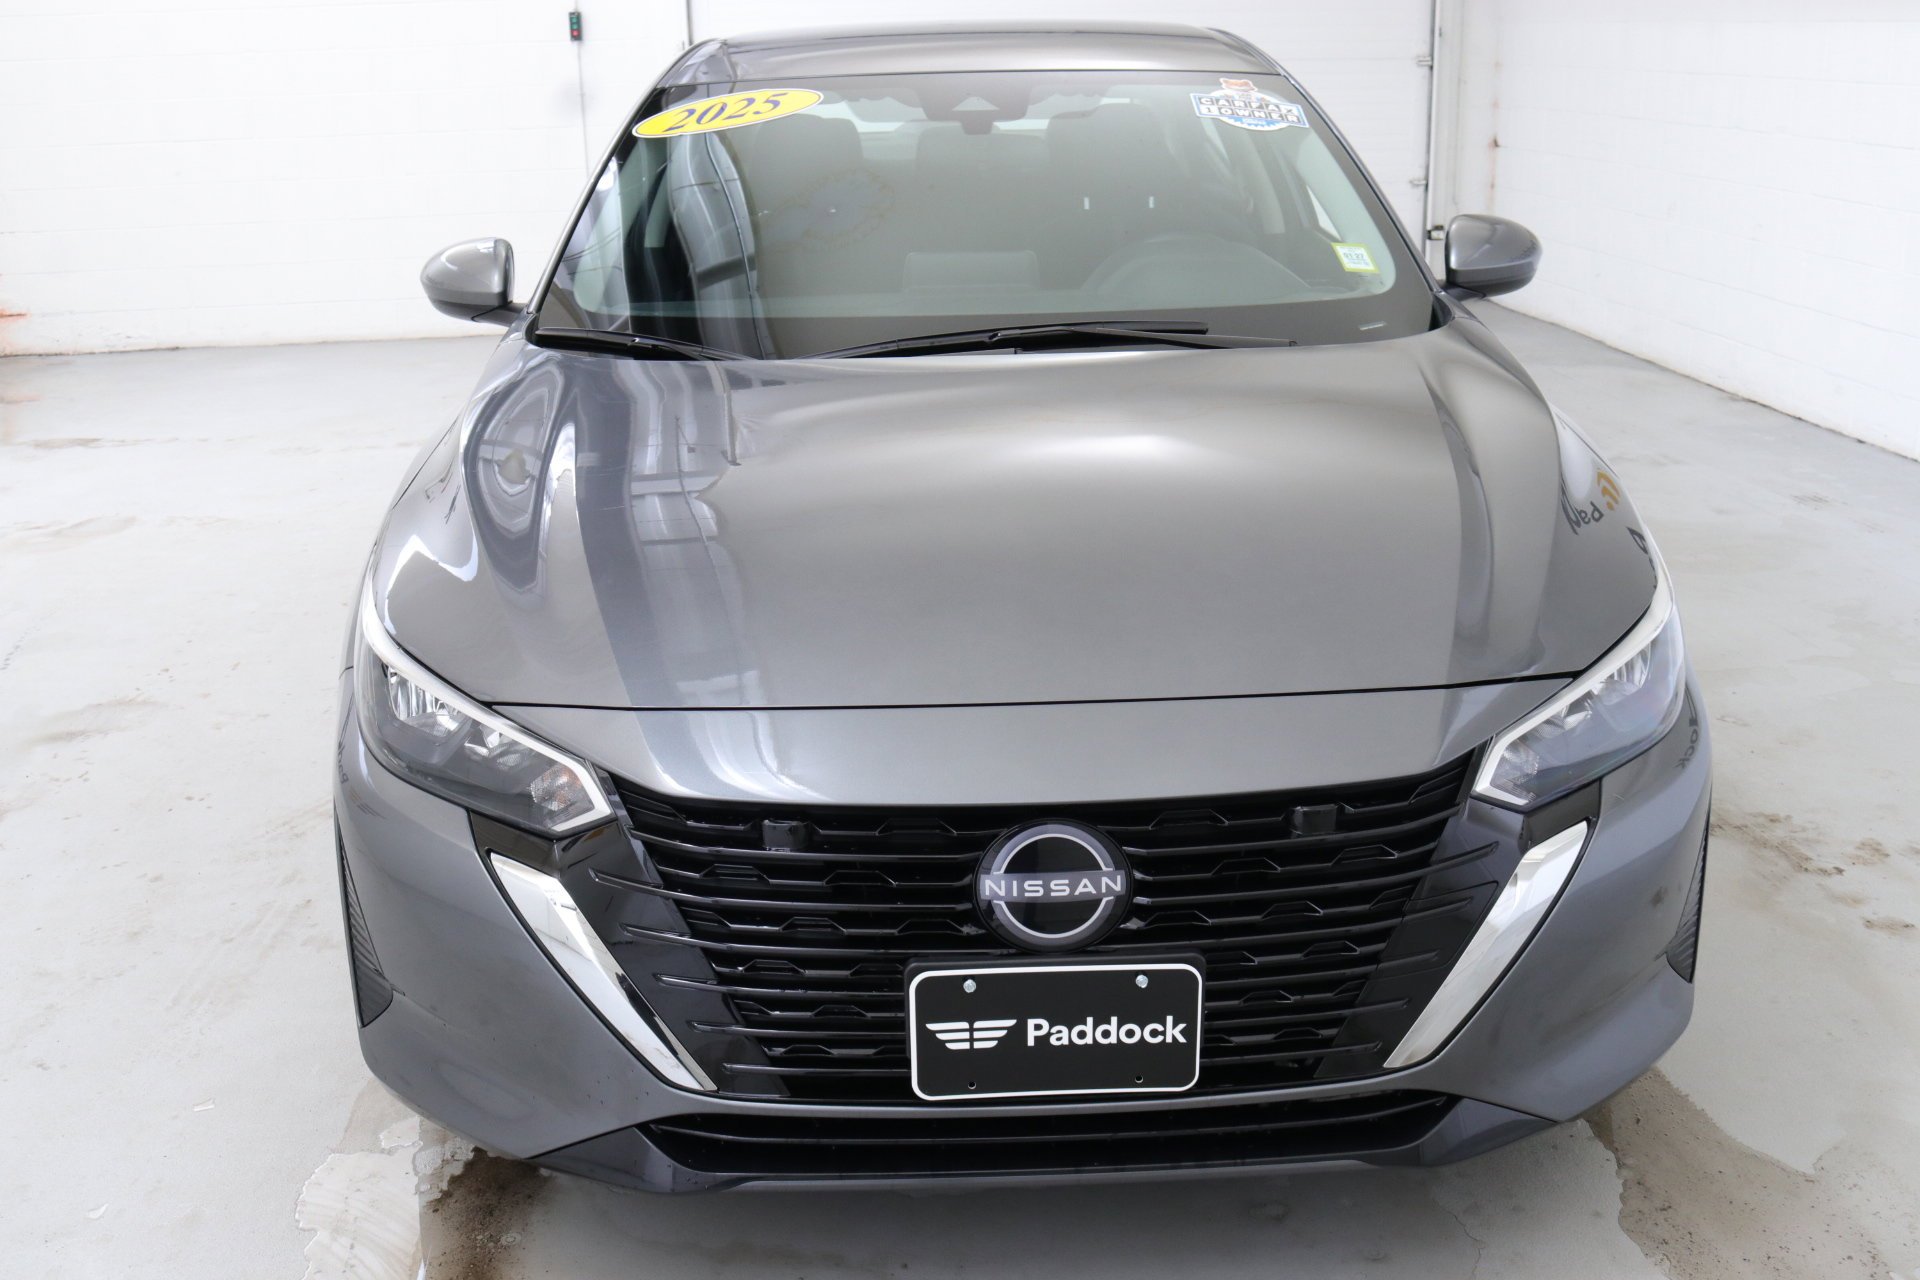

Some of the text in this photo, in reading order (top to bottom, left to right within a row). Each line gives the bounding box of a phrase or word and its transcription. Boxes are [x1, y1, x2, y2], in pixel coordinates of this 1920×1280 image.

[662, 92, 788, 132] 2025
[1200, 97, 1297, 114] CARFAX
[1219, 108, 1300, 123] OWNER
[985, 875, 1121, 897] NISSAN
[1027, 1015, 1187, 1046] Paddock
